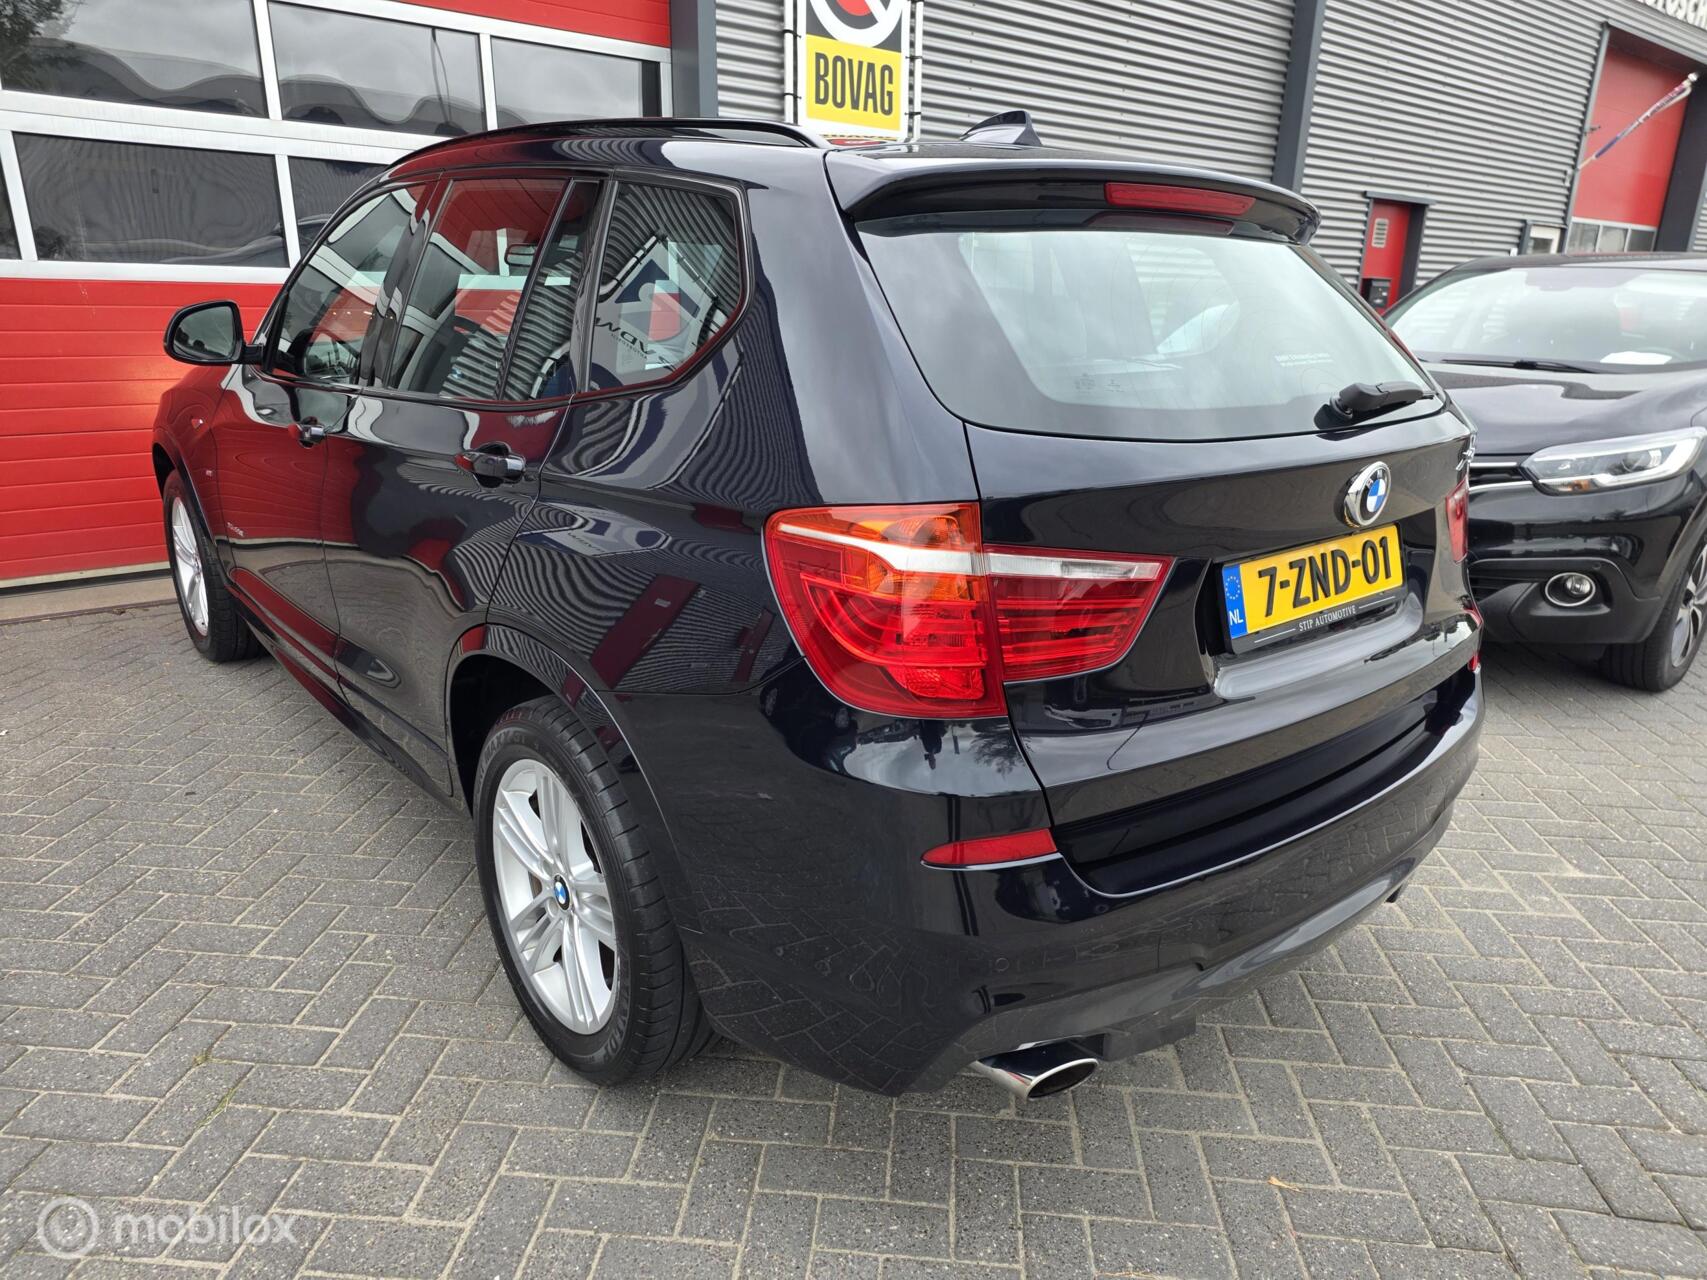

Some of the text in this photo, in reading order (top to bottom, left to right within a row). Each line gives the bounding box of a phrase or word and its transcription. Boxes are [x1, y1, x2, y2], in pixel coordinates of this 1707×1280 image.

[815, 52, 893, 116] BOVAG
[1258, 536, 1391, 617] 7-ZND-01
[1228, 610, 1244, 626] NL
[1299, 605, 1356, 632] STIP AUTOMOTIVE
